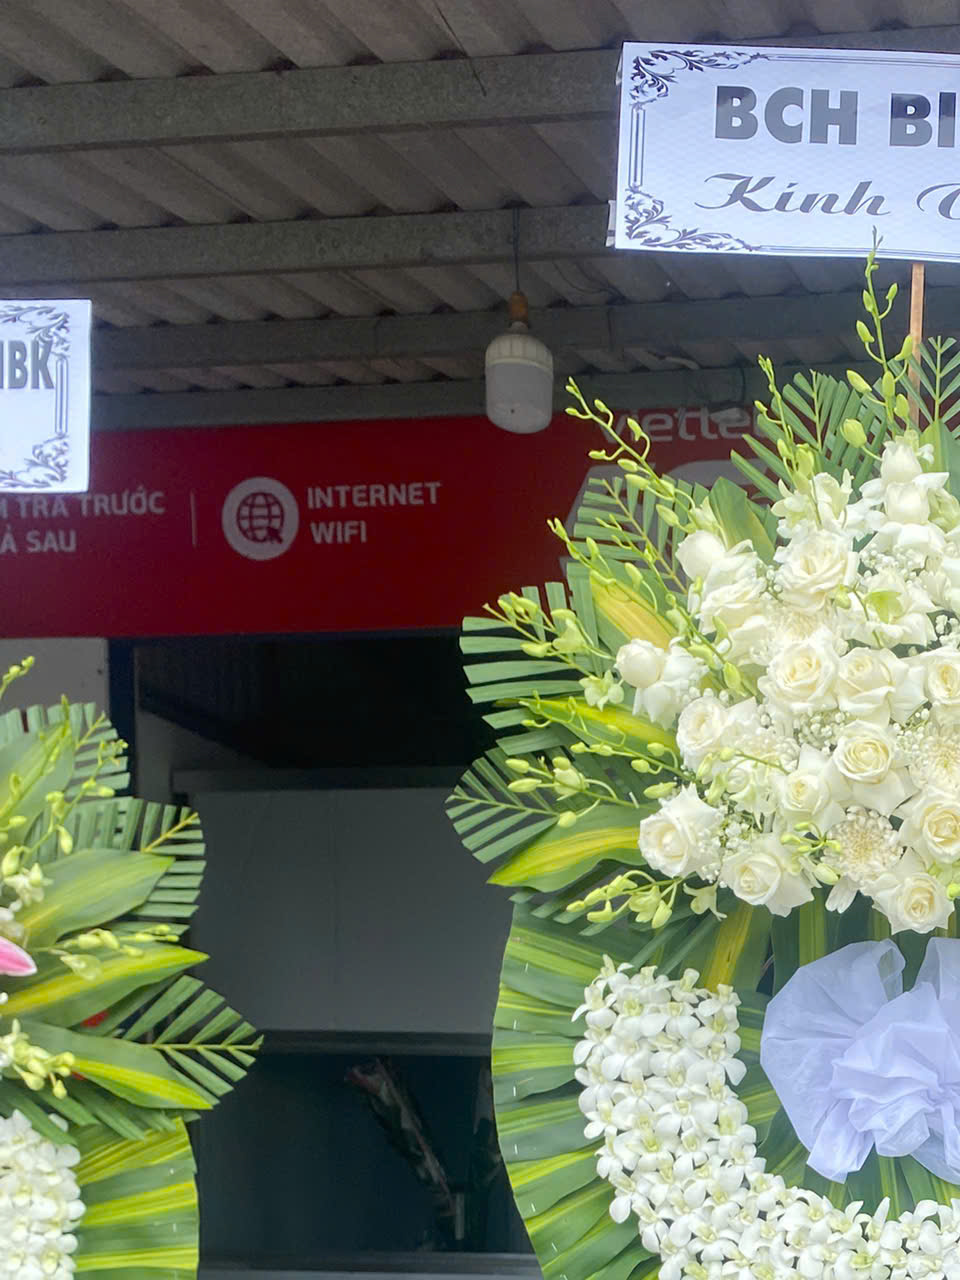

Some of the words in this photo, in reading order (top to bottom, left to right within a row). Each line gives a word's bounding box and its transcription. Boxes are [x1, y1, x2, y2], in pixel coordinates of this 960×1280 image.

[714, 85, 859, 145] BCH
[694, 172, 891, 217] Kính
[0, 340, 54, 389] BK
[307, 482, 441, 509] INTERNET
[26, 529, 77, 554] SAU
[310, 521, 367, 545] WIFI
